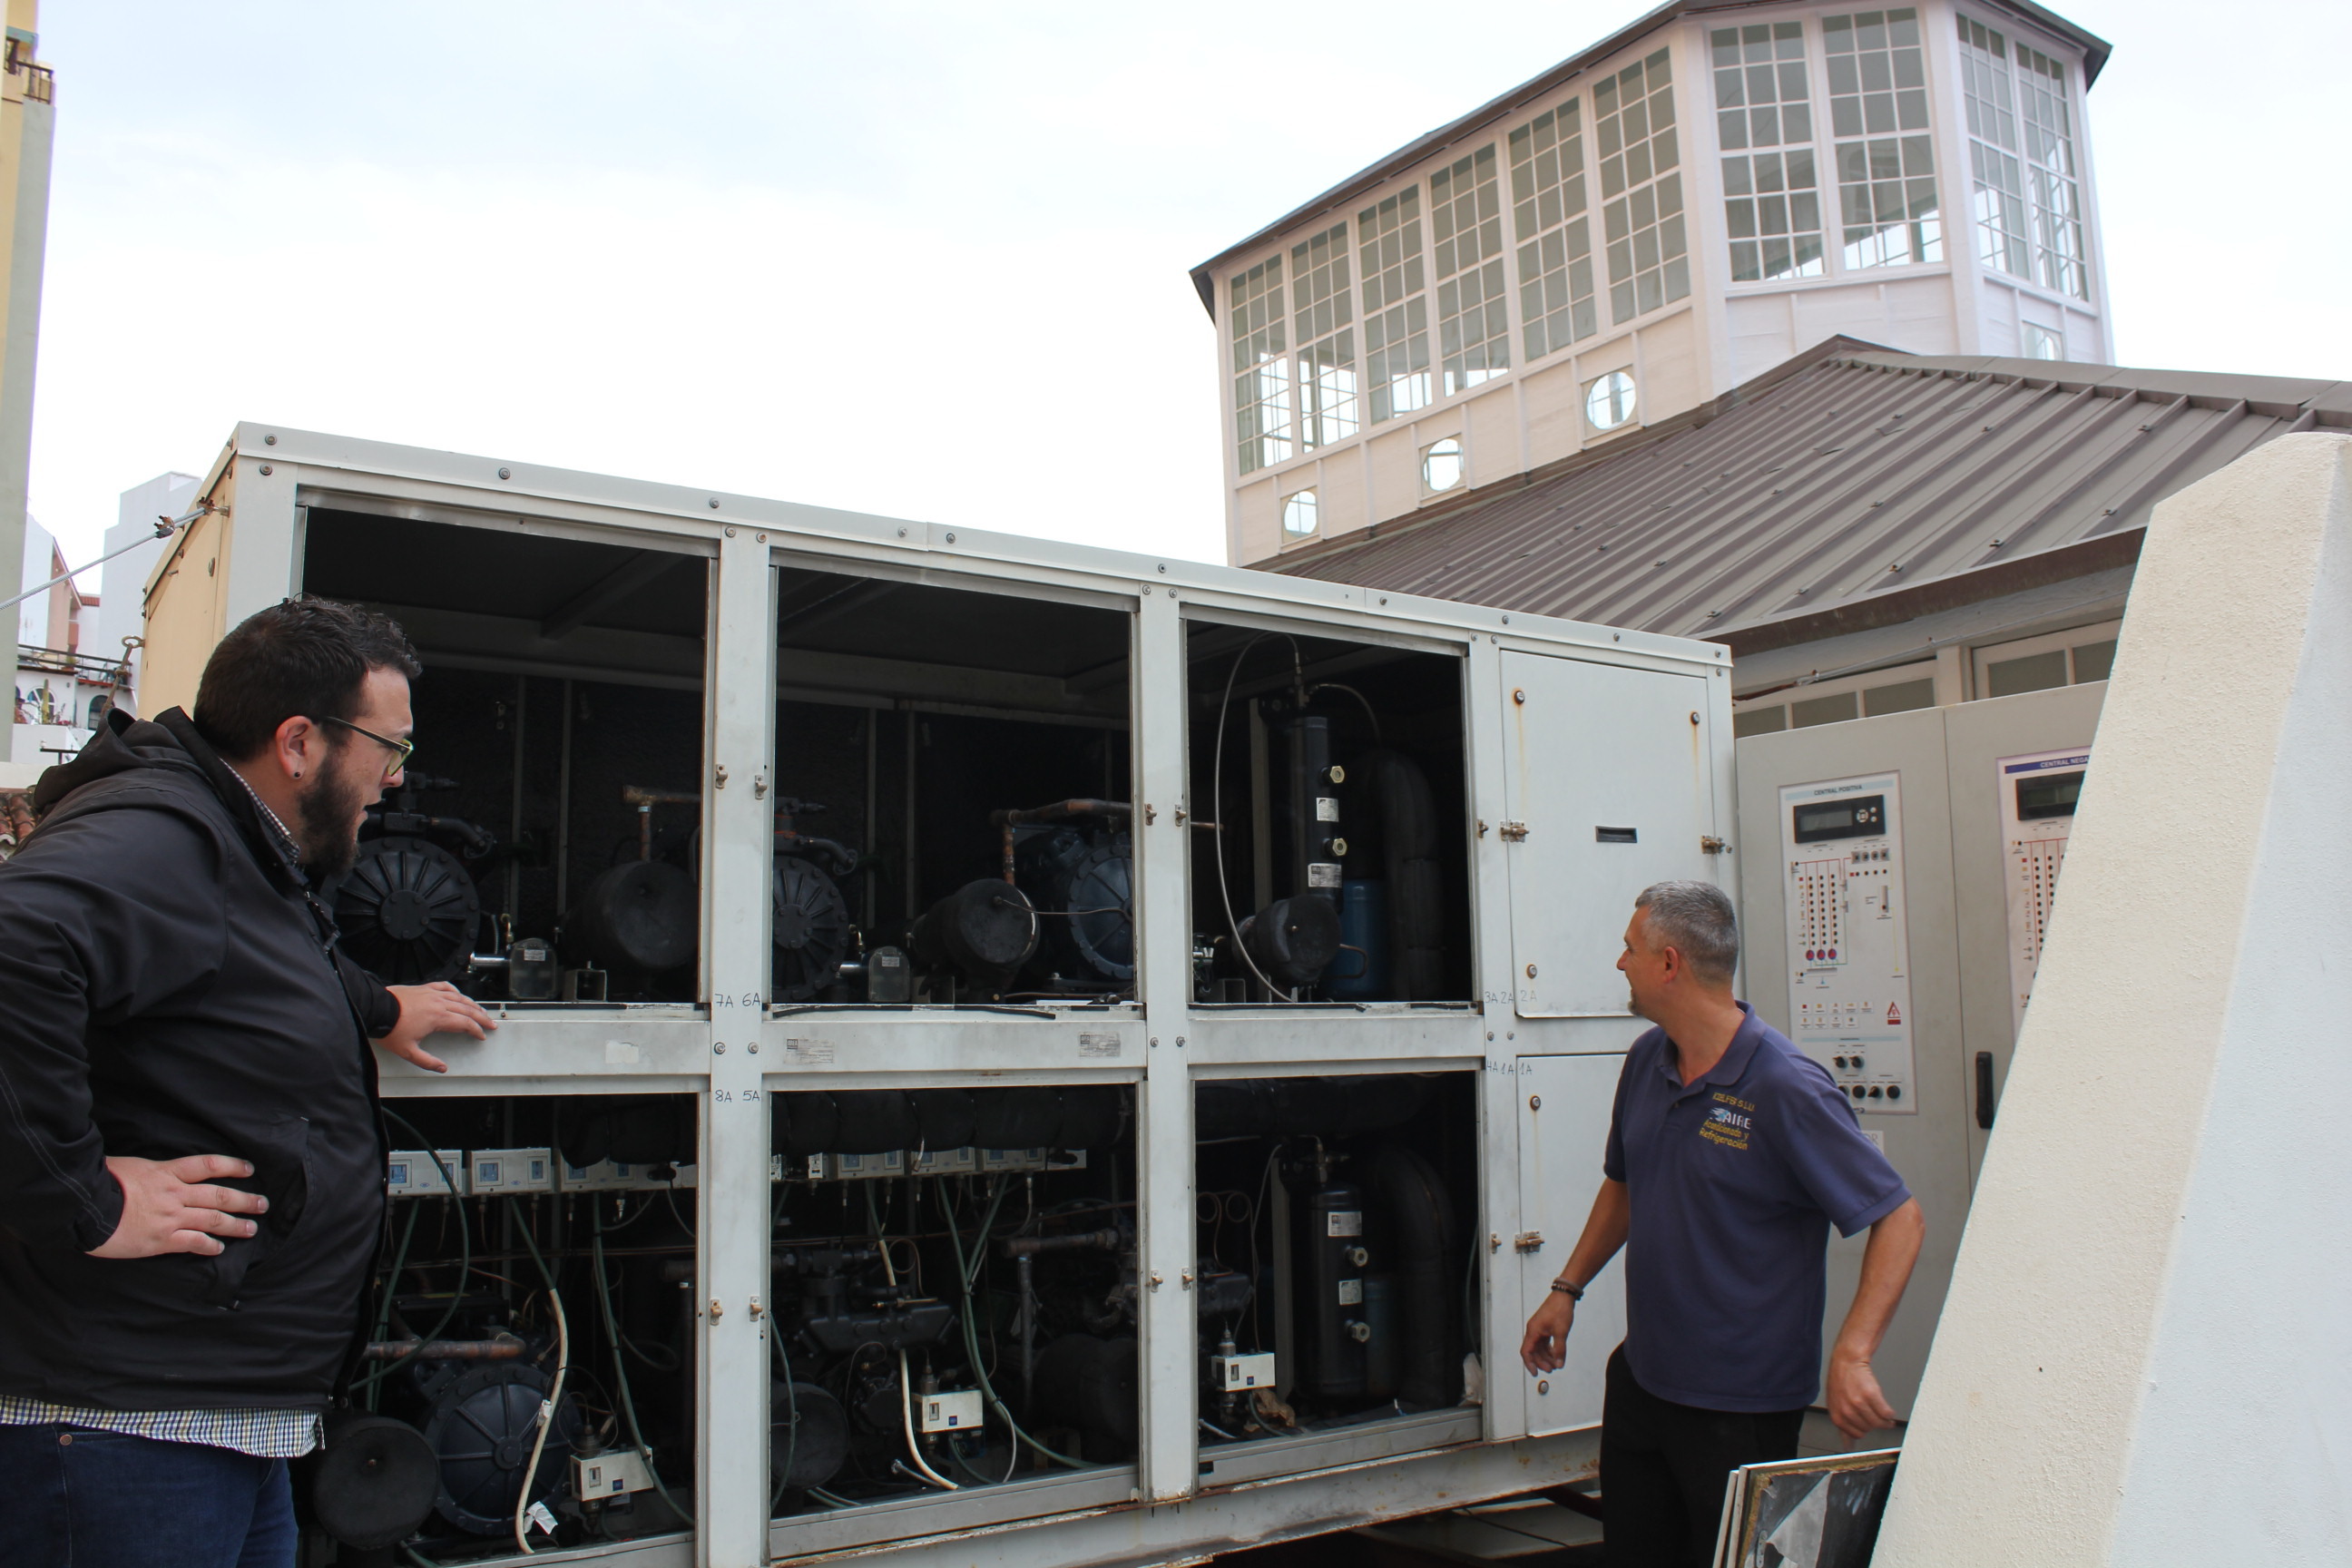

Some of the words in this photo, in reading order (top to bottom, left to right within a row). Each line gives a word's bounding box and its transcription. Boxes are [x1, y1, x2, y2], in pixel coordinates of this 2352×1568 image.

[2040, 760, 2070, 769] CENTRAL
[2070, 756, 2089, 764] NEGA
[1814, 787, 1838, 796] CENTRAL
[1838, 784, 1863, 793] POSITIVA
[714, 993, 734, 1008] 7A
[742, 992, 760, 1006] 6A
[1485, 991, 1498, 1004] 3A
[1500, 991, 1514, 1004] 2A
[1520, 989, 1538, 1002] 2A
[1486, 1060, 1498, 1072] 4A
[1500, 1063, 1514, 1076] 1A
[1520, 1062, 1533, 1075] 1A
[715, 1089, 732, 1102] 8A
[742, 1090, 760, 1102] 5A
[1722, 1111, 1752, 1130] AIRE
